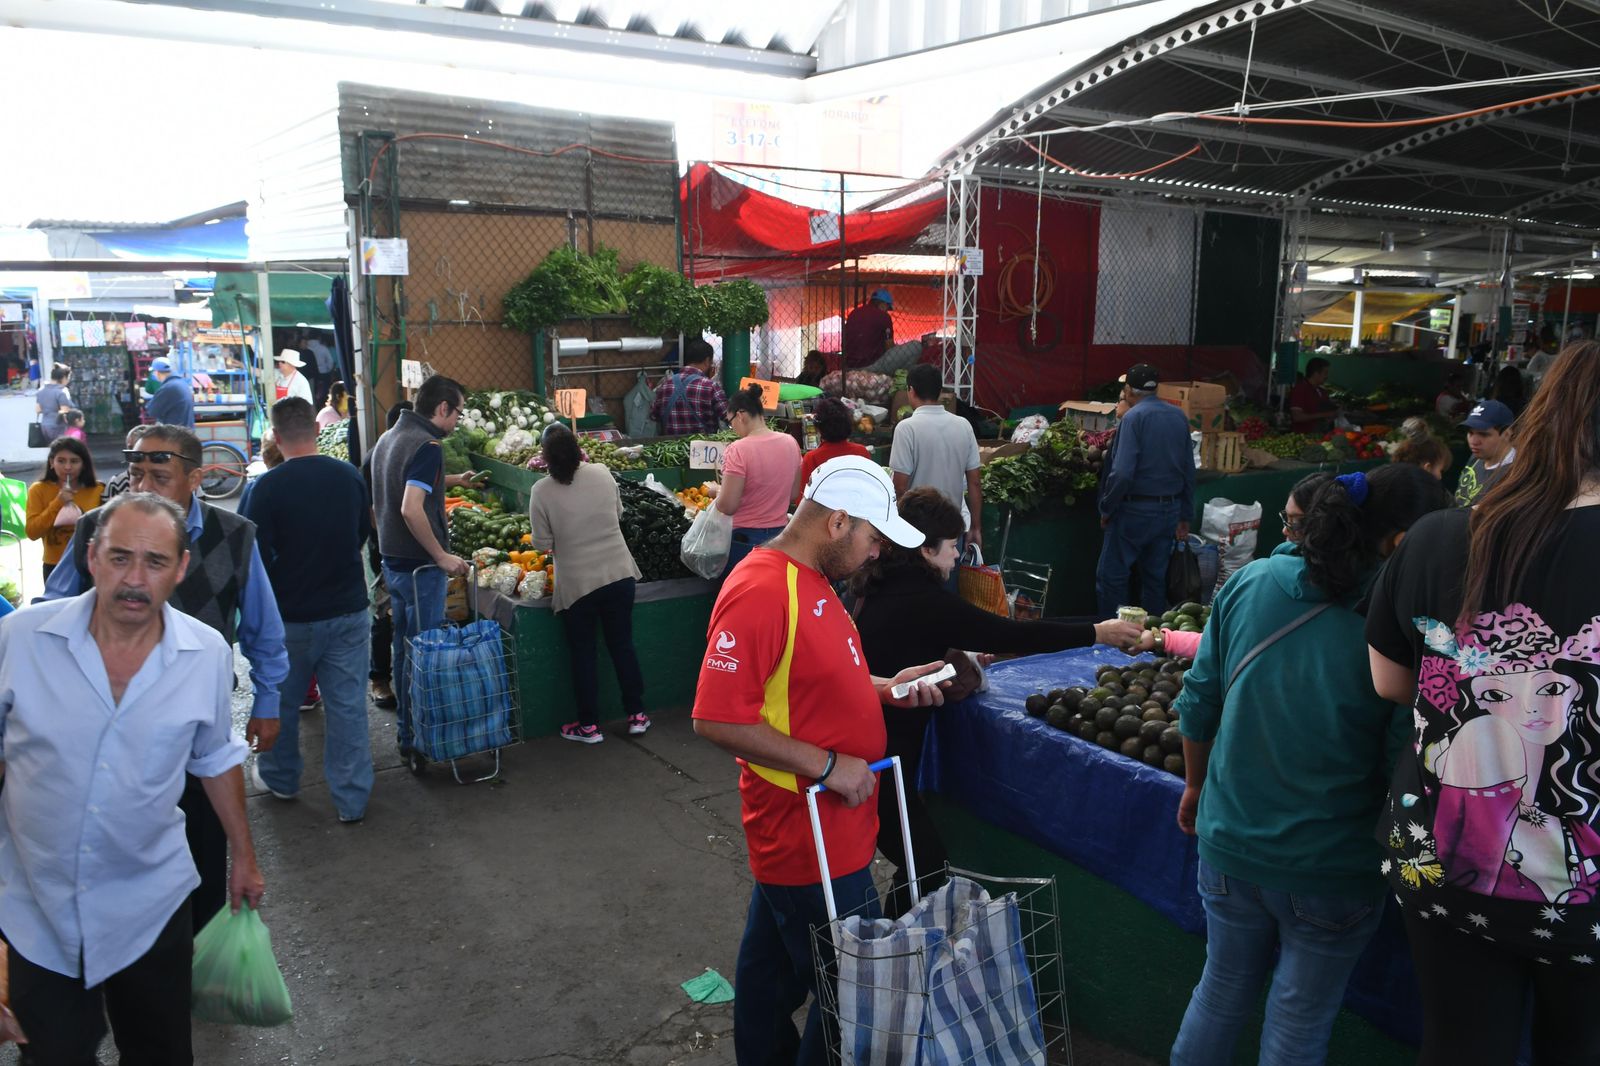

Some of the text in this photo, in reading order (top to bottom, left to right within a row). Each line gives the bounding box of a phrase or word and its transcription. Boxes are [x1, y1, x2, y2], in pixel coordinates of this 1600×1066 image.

[703, 446, 718, 464] 10
[848, 637, 860, 666] 5
[707, 658, 737, 670] FMVB
